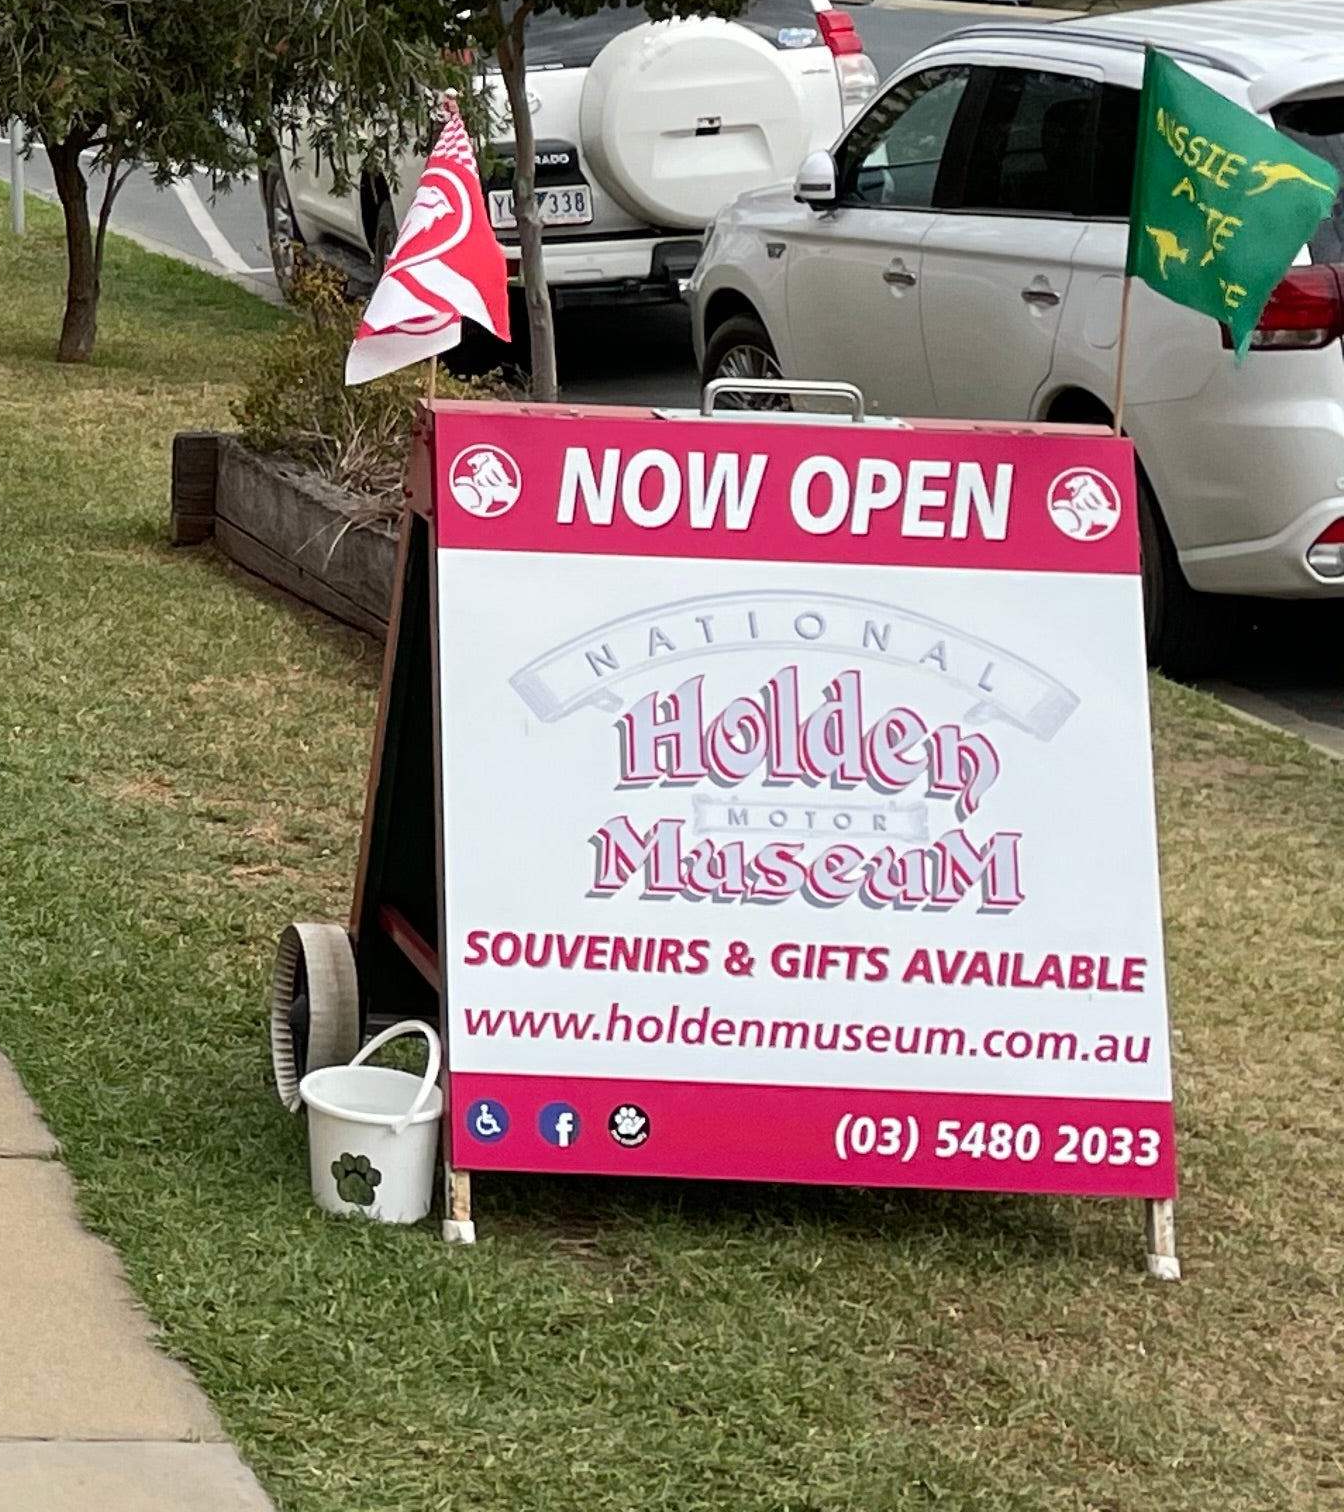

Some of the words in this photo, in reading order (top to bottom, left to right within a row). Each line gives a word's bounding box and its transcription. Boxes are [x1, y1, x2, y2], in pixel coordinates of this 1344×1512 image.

[549, 192, 585, 214] 338
[556, 446, 769, 531] NOW
[789, 454, 1014, 541] OPEN
[584, 611, 995, 693] NATIONAL
[613, 665, 1000, 823] Holden
[727, 808, 888, 832] MOTOR
[463, 929, 711, 975] SOUVENIRS
[723, 940, 756, 978] &
[770, 942, 890, 983] GIFTS
[902, 948, 1149, 994] AVAILABLE
[463, 1002, 1152, 1064] www.holdenmuseum.com.au
[834, 1113, 920, 1163] (03)
[934, 1119, 1042, 1163] 5480
[1053, 1124, 1162, 1168] 2033
